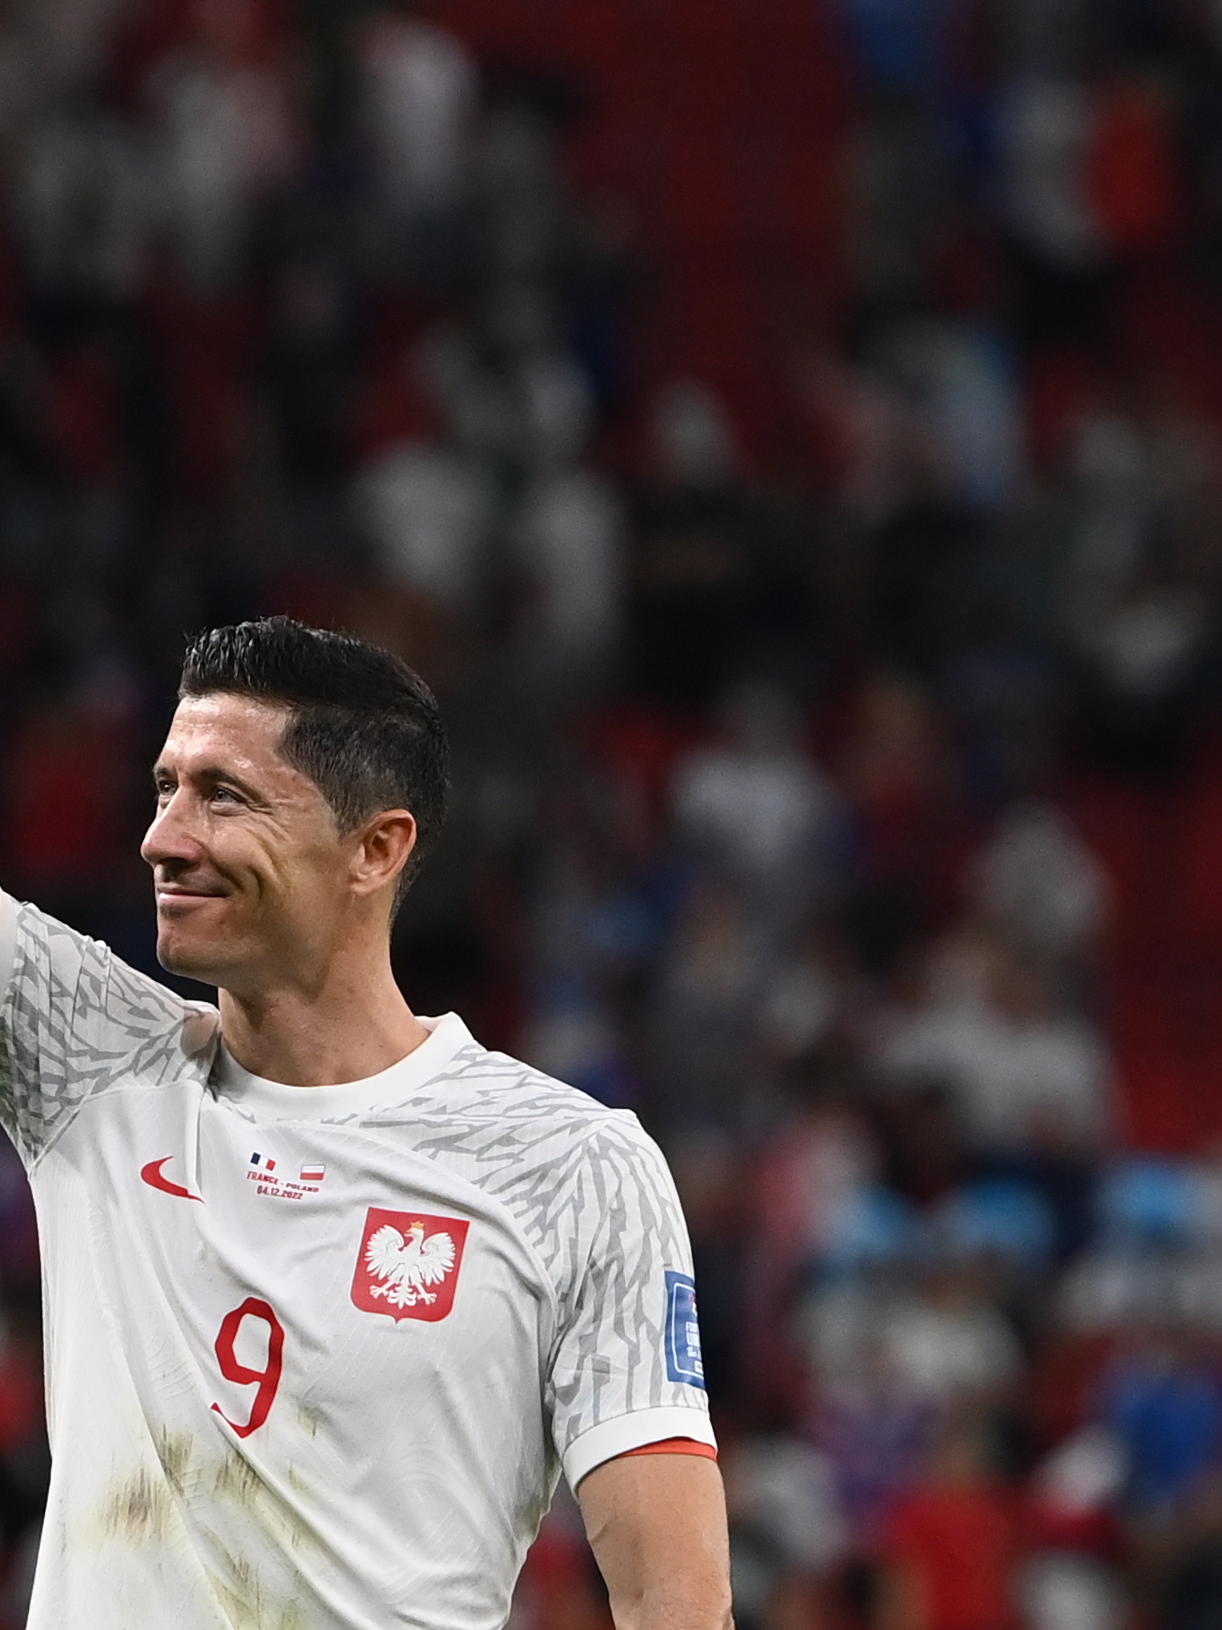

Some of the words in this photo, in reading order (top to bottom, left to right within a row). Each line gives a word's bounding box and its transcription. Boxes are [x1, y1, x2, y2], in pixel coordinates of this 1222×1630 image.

[247, 1171, 279, 1185] FRANCE
[286, 1183, 320, 1192] POLAND
[257, 1185, 303, 1200] 04.12.2022
[210, 1297, 285, 1439] 9
